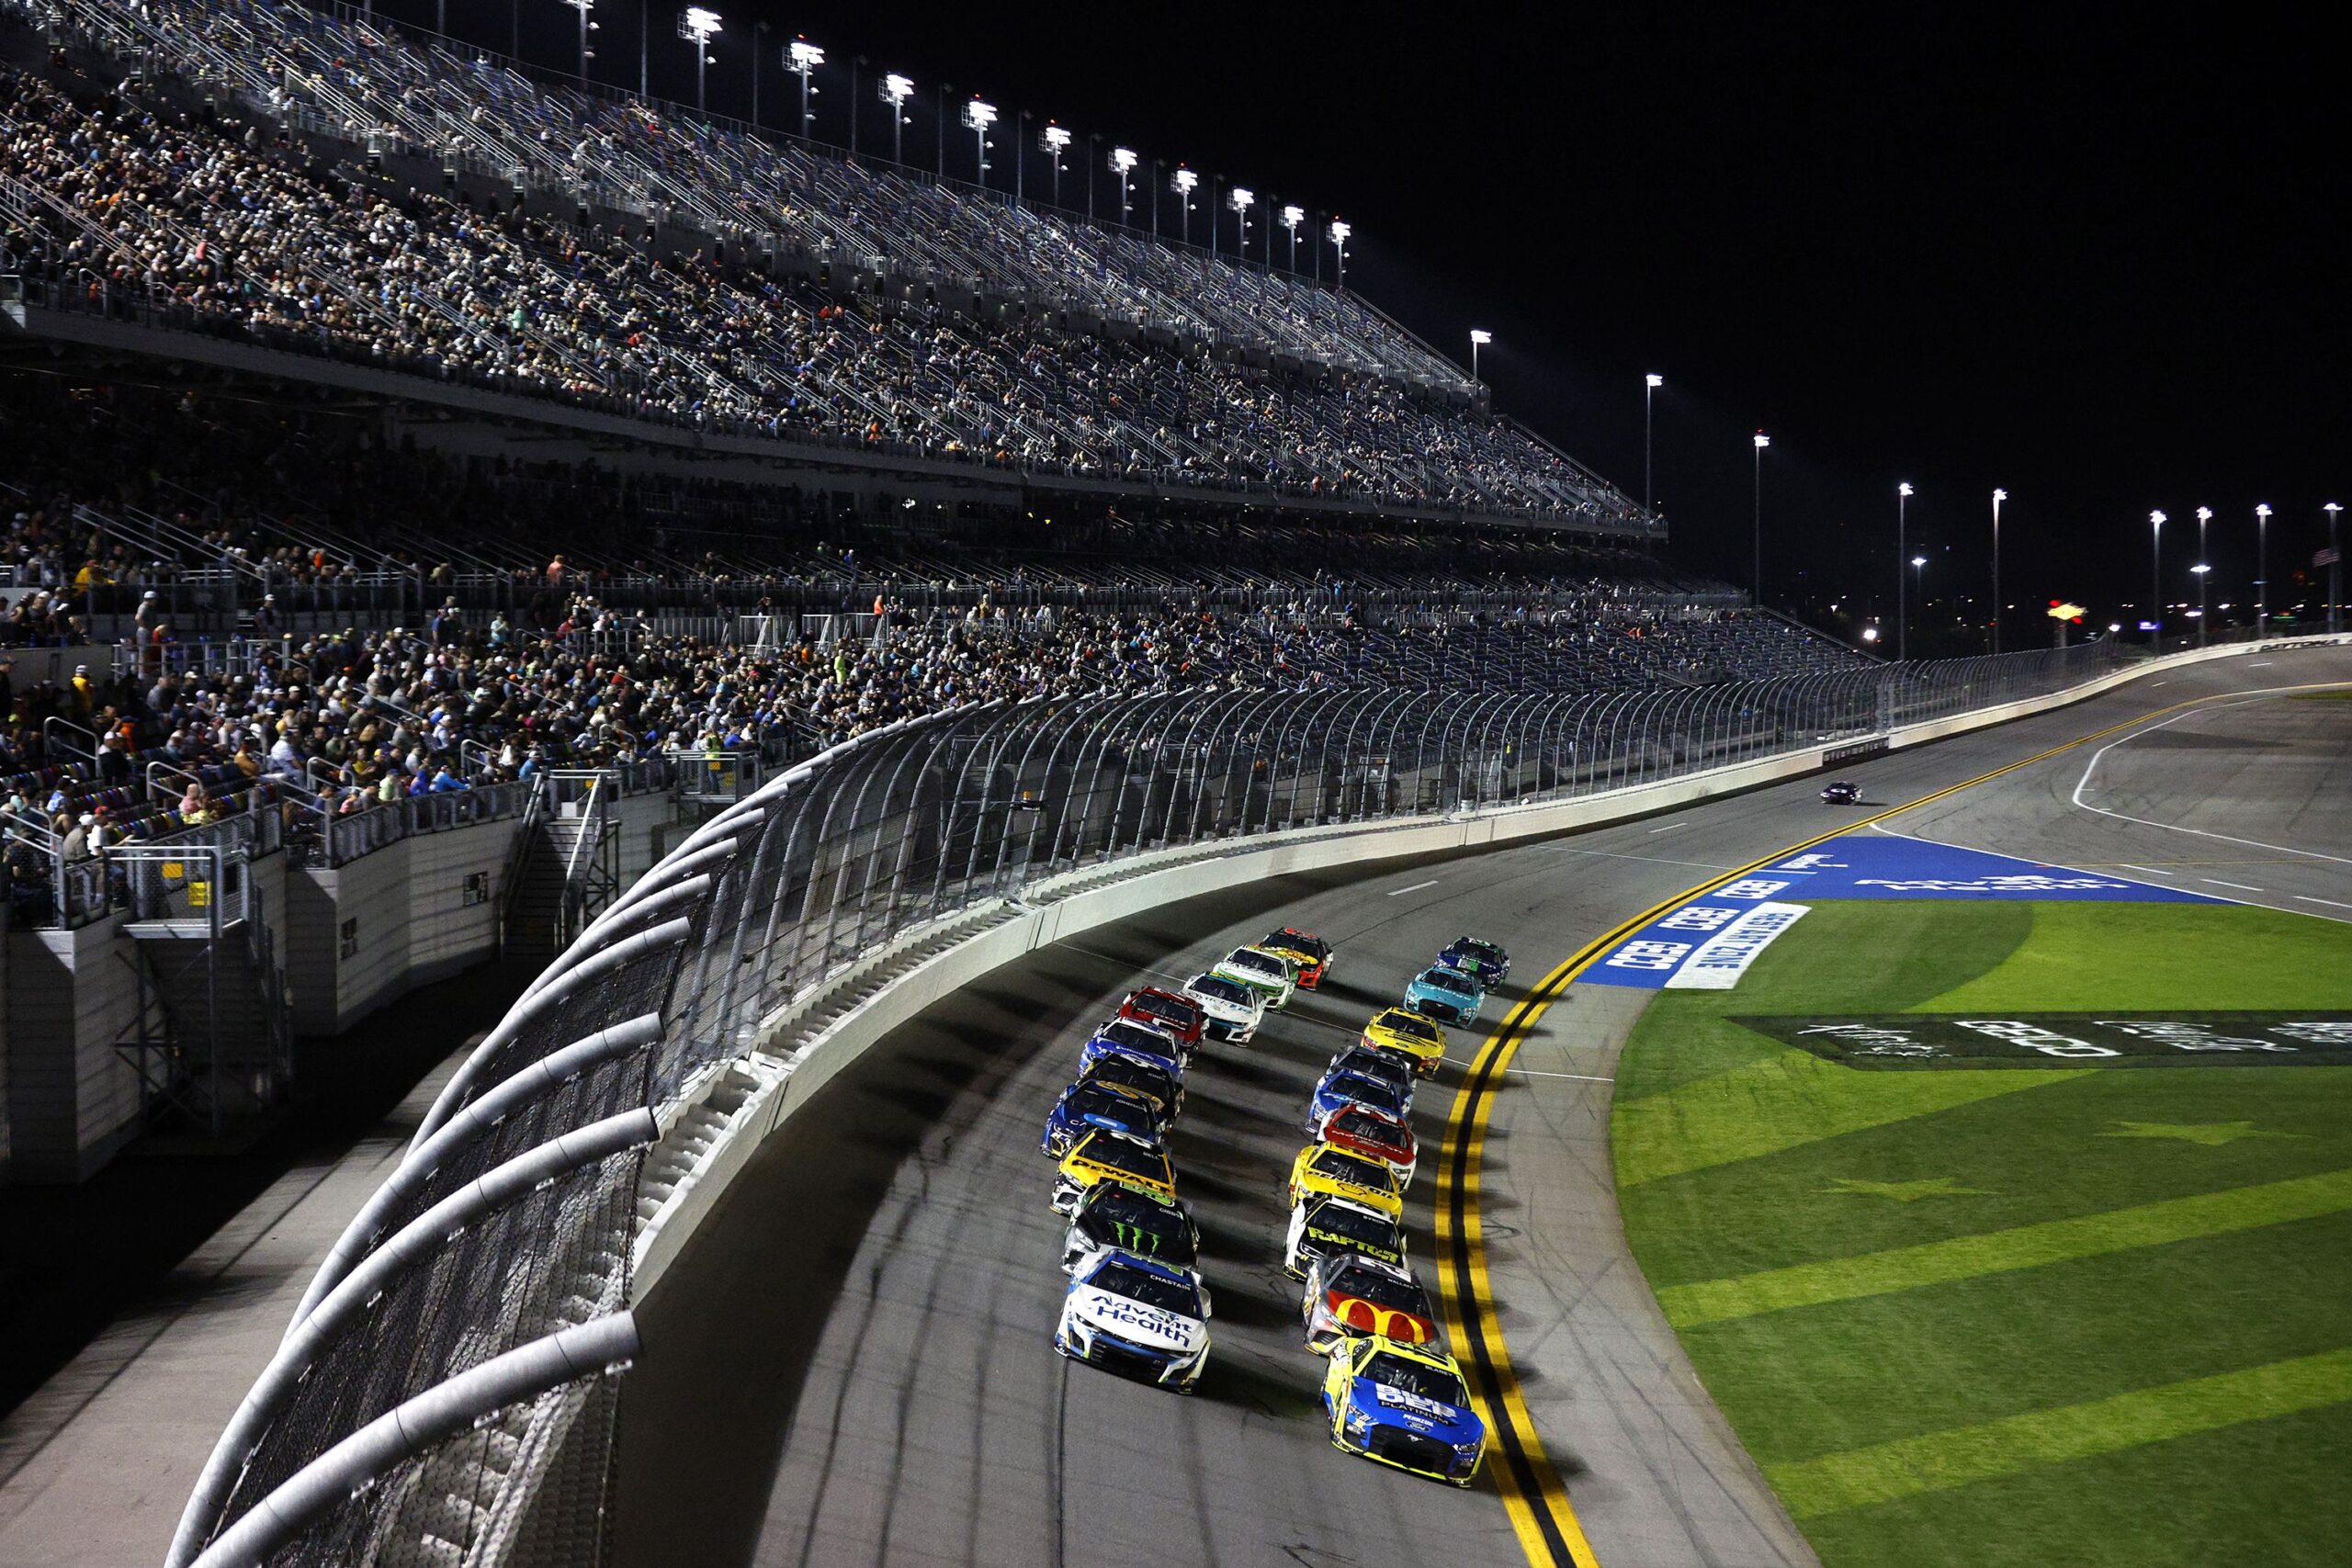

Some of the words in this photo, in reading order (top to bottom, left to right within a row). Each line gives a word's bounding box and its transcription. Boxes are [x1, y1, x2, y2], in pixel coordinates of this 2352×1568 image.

[1724, 912, 1793, 943] RESTART
[1696, 946, 1754, 969] ZONE
[1952, 1021, 2123, 1057] GEICO
[1363, 1215, 1386, 1225] BYRON
[1307, 1226, 1398, 1264] RAPTOR
[1149, 1274, 1192, 1291] CHASTAIN
[1387, 1278, 1415, 1289] WALLACE
[1091, 1295, 1193, 1333] Advent
[1097, 1306, 1190, 1348] Health
[1425, 1365, 1452, 1377] BLANEY
[1381, 1401, 1449, 1425] PLATINUM
